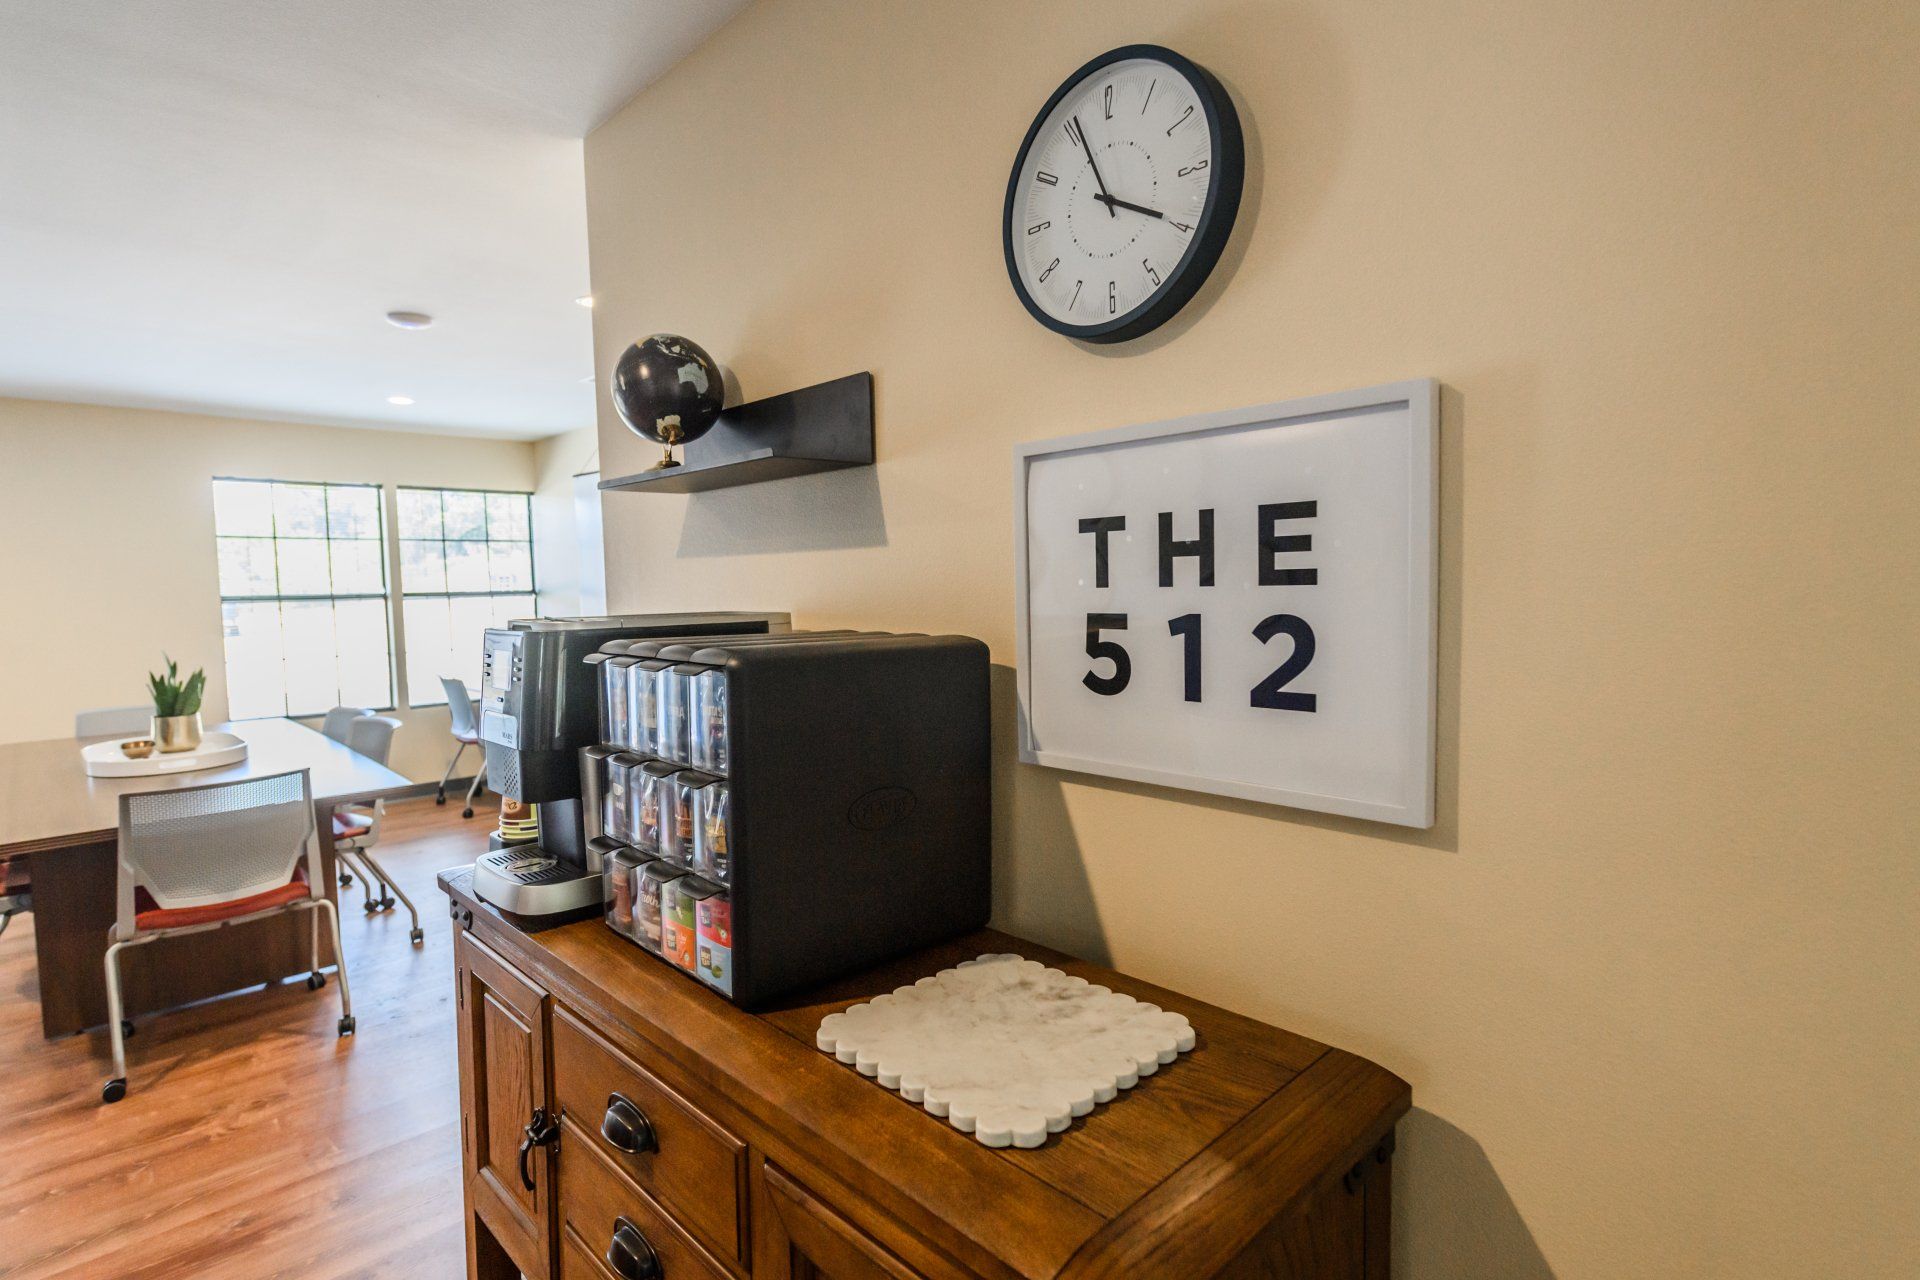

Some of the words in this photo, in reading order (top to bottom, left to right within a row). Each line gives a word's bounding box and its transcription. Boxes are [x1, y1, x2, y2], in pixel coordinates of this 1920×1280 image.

[1104, 84, 1113, 120] 12
[1166, 105, 1194, 137] 2
[1036, 171, 1058, 186] 10
[1178, 159, 1208, 177] 3
[1027, 221, 1051, 235] 9
[1169, 221, 1195, 232] 4
[1039, 257, 1060, 283] 8
[1142, 258, 1161, 287] 5
[1069, 280, 1083, 311] 7
[1109, 281, 1115, 314] 6
[1078, 500, 1318, 588] THE
[1082, 612, 1317, 713] 512
